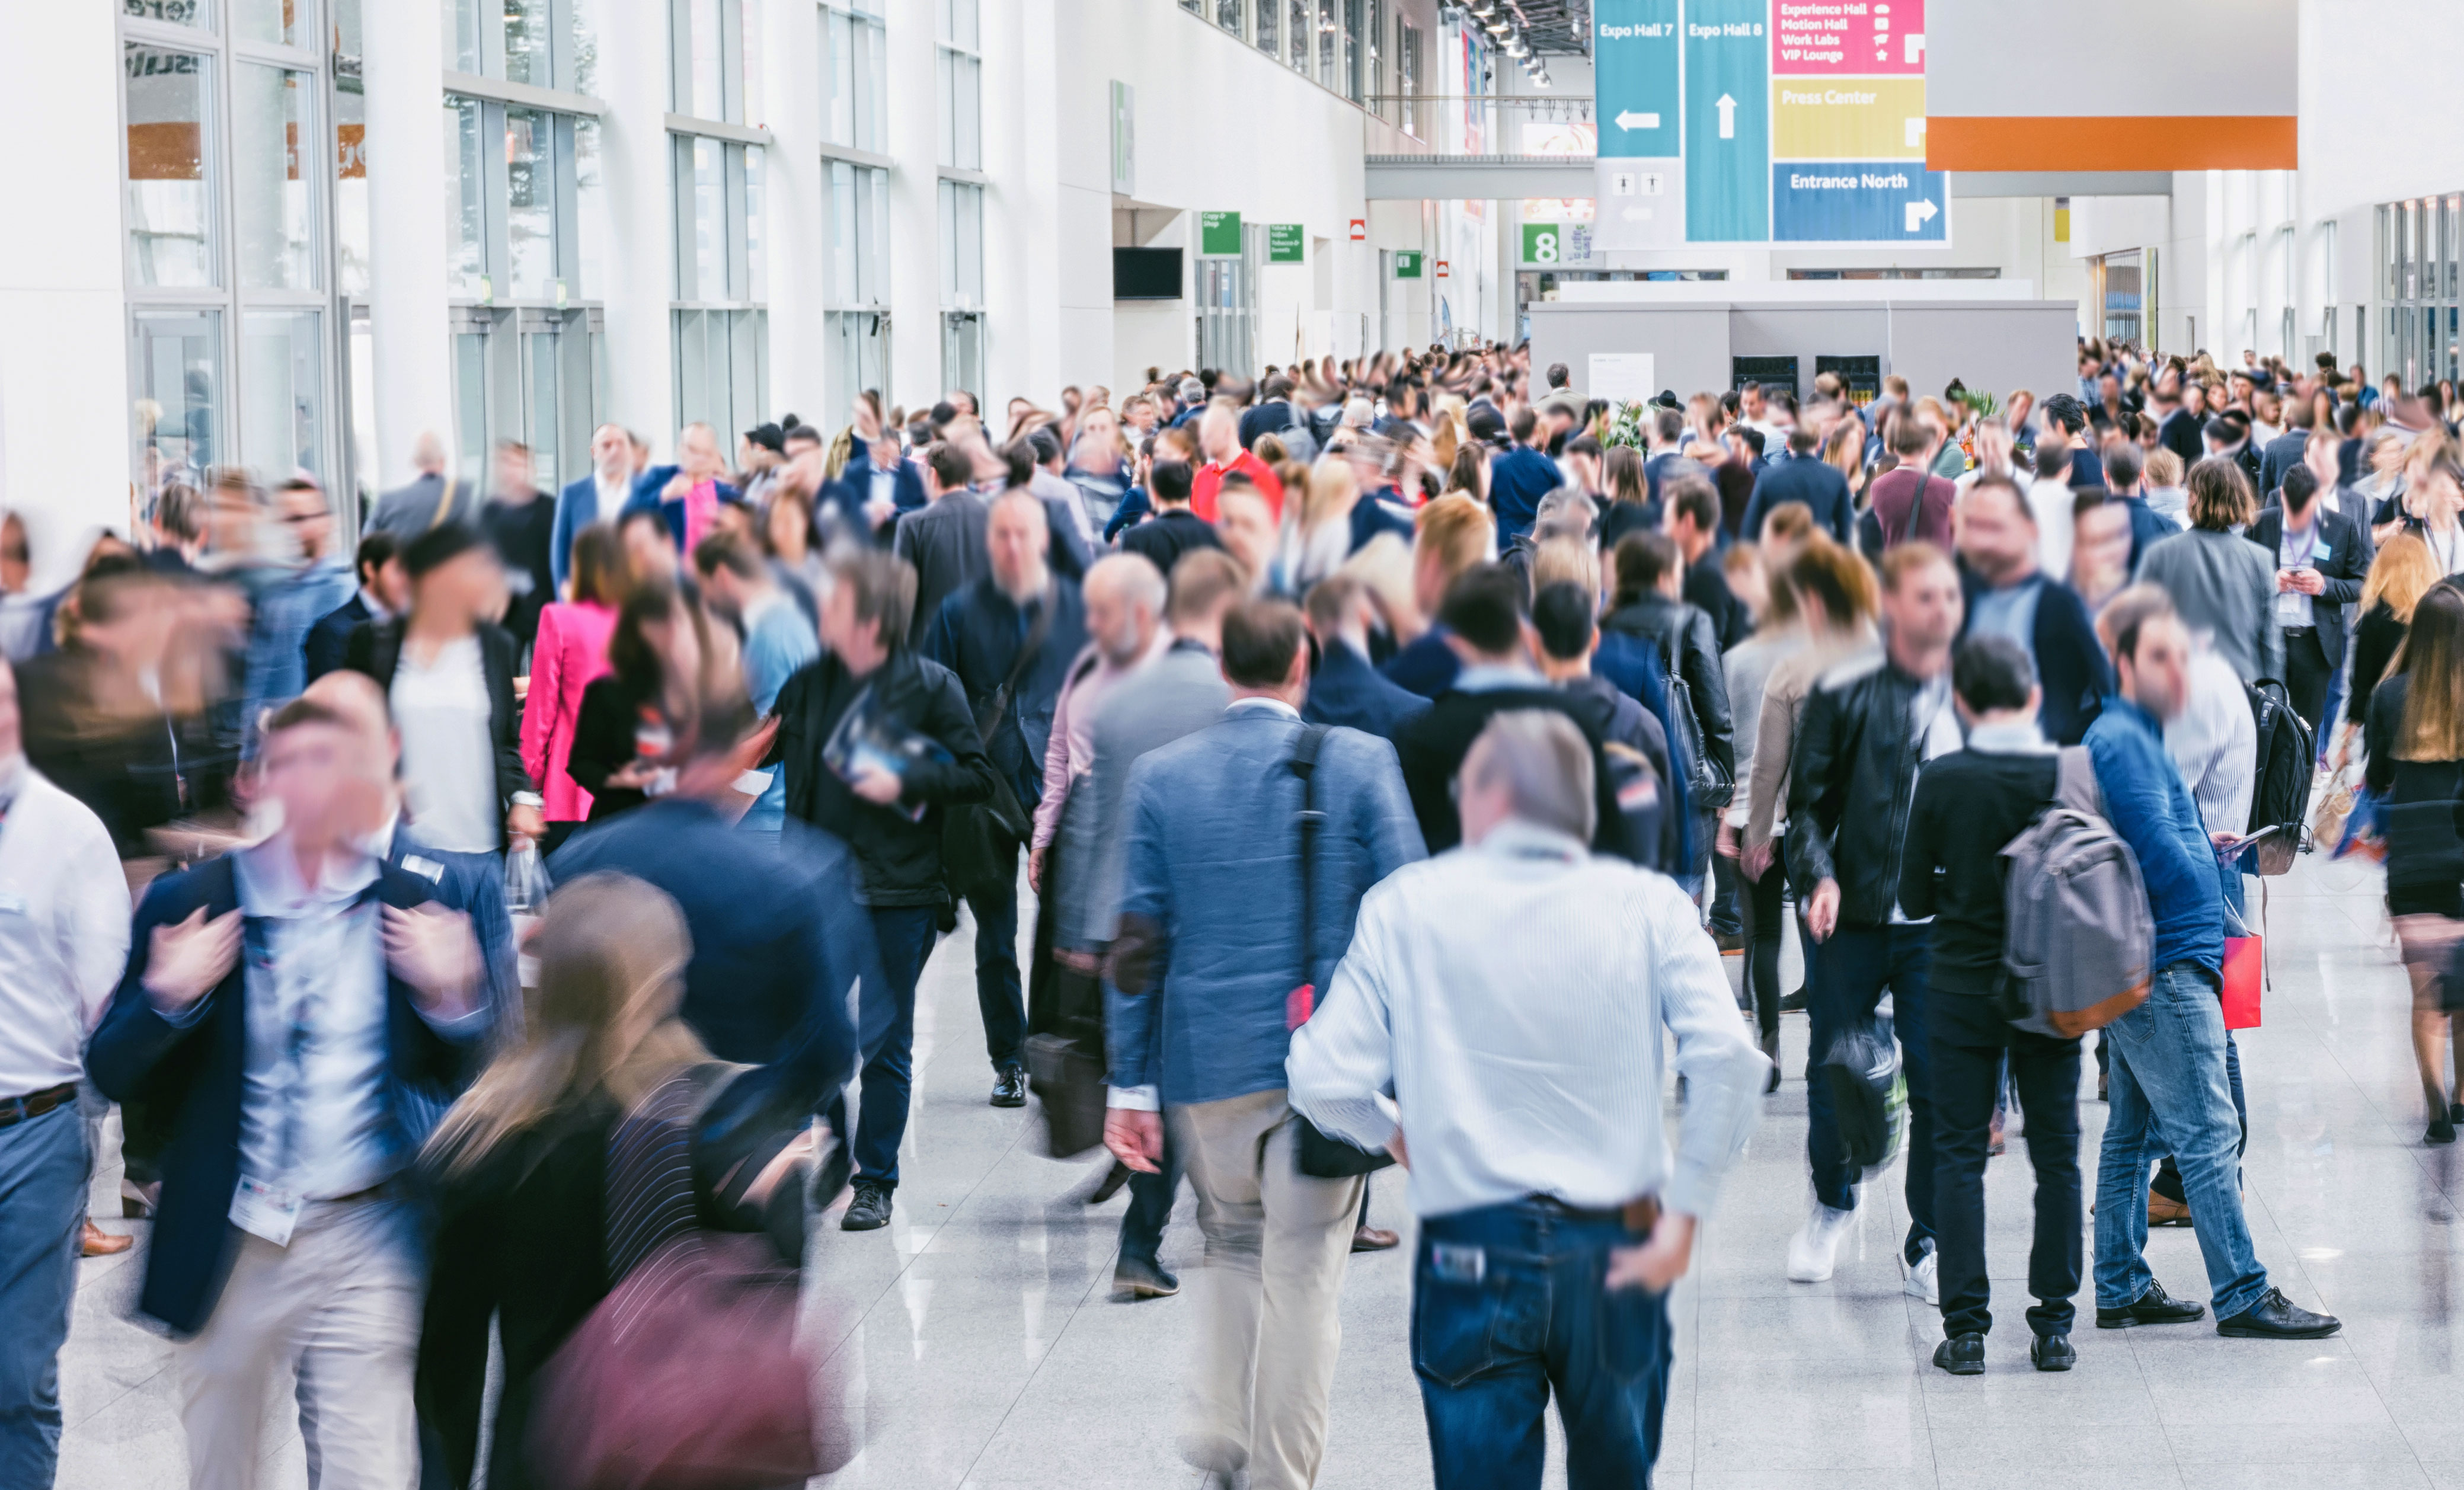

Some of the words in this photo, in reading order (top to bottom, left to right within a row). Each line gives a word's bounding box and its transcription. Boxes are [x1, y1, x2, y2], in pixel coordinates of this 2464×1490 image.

[1781, 4, 1842, 18] Experience
[1843, 3, 1867, 15] Hall
[1600, 24, 1632, 40] Expo
[1634, 23, 1662, 37] Hall
[1664, 24, 1674, 37] 7
[1689, 24, 1721, 40] Expo
[1724, 23, 1750, 36] Hall
[1753, 24, 1763, 36] 8
[1781, 18, 1822, 30] Motion
[1824, 18, 1848, 30] Hall
[1781, 33, 1813, 46] Work
[1814, 33, 1840, 46] Labs
[1781, 49, 1801, 60] VIP
[1803, 49, 1844, 63] Lounge
[1782, 90, 1823, 105] Press
[1824, 90, 1877, 105] Center
[1791, 174, 1858, 189] Entrance
[1861, 172, 1908, 189] North
[1203, 220, 1219, 228] Shop
[1535, 232, 1557, 264] 8
